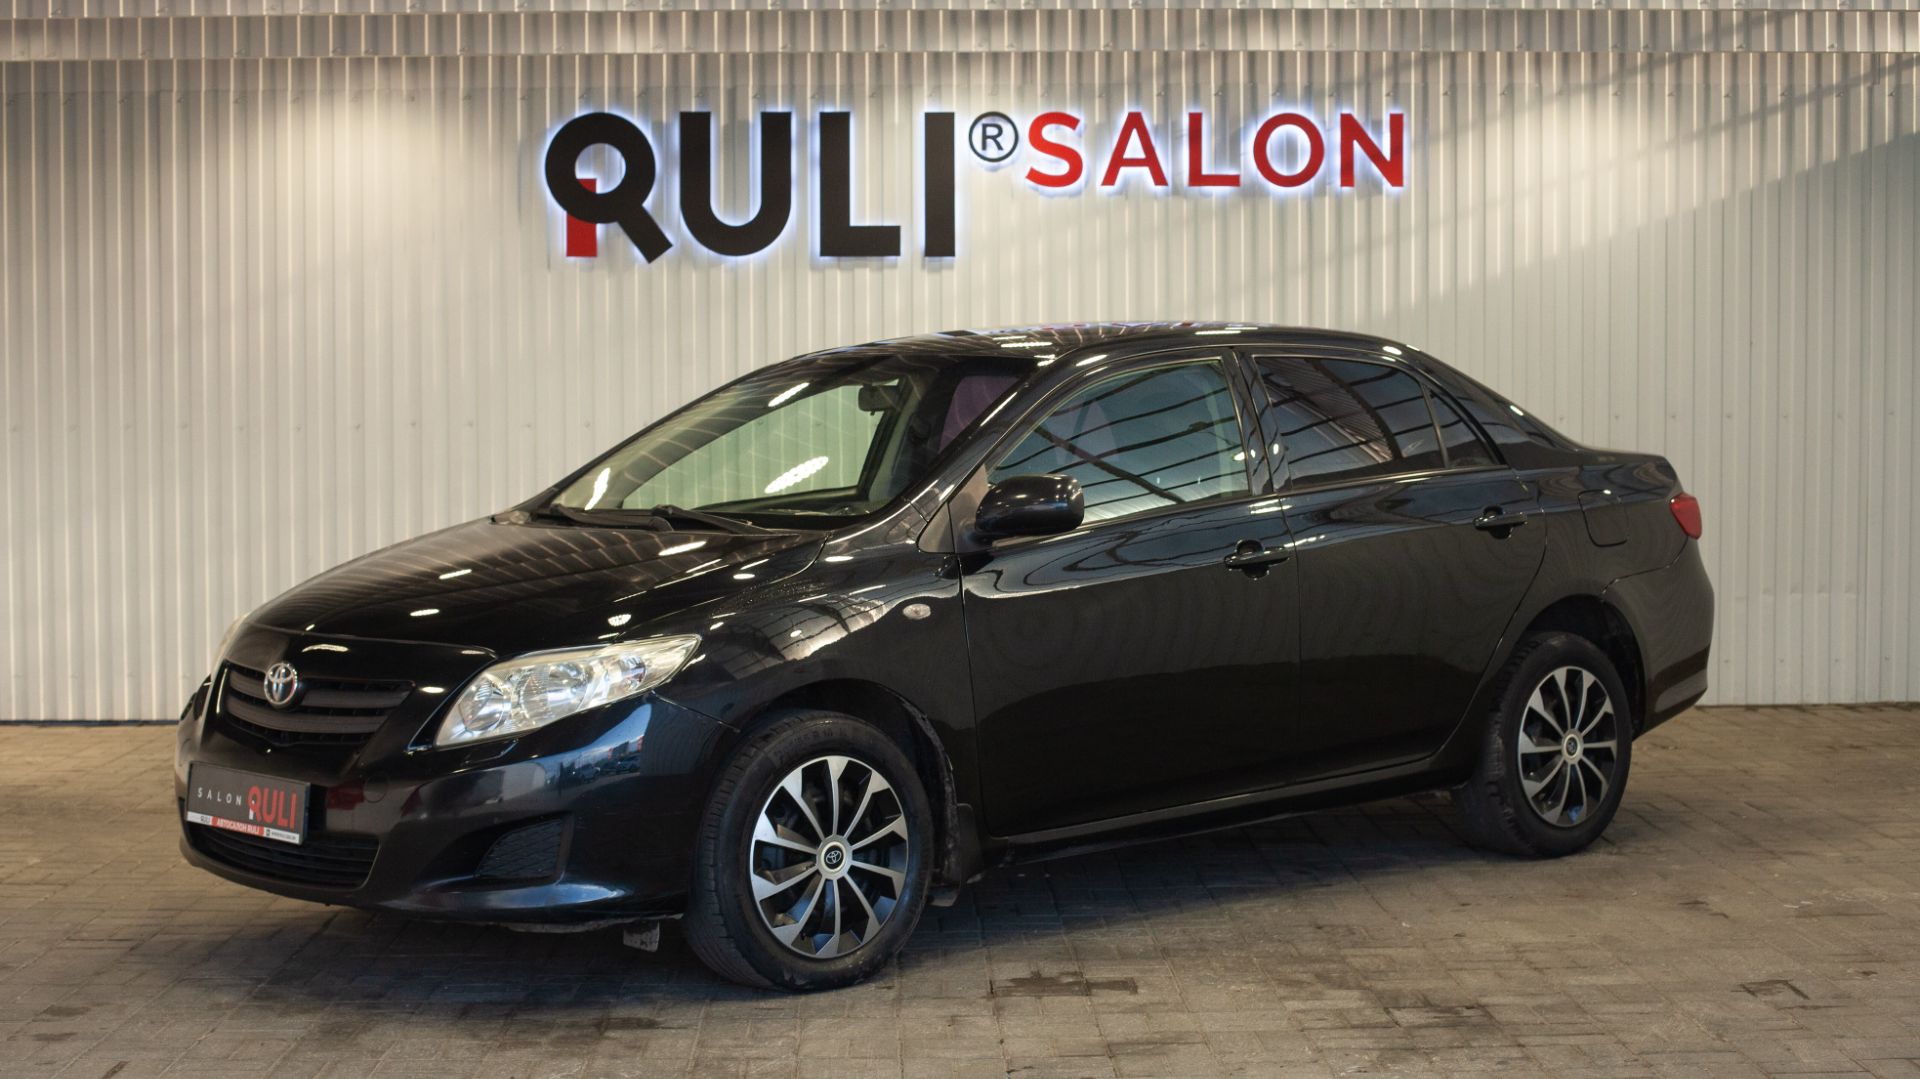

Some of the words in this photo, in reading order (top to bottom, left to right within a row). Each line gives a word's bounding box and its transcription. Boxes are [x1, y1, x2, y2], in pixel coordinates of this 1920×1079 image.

[1025, 111, 1404, 188] SALON
[197, 787, 242, 806] SALON
[247, 785, 297, 829] RULI
